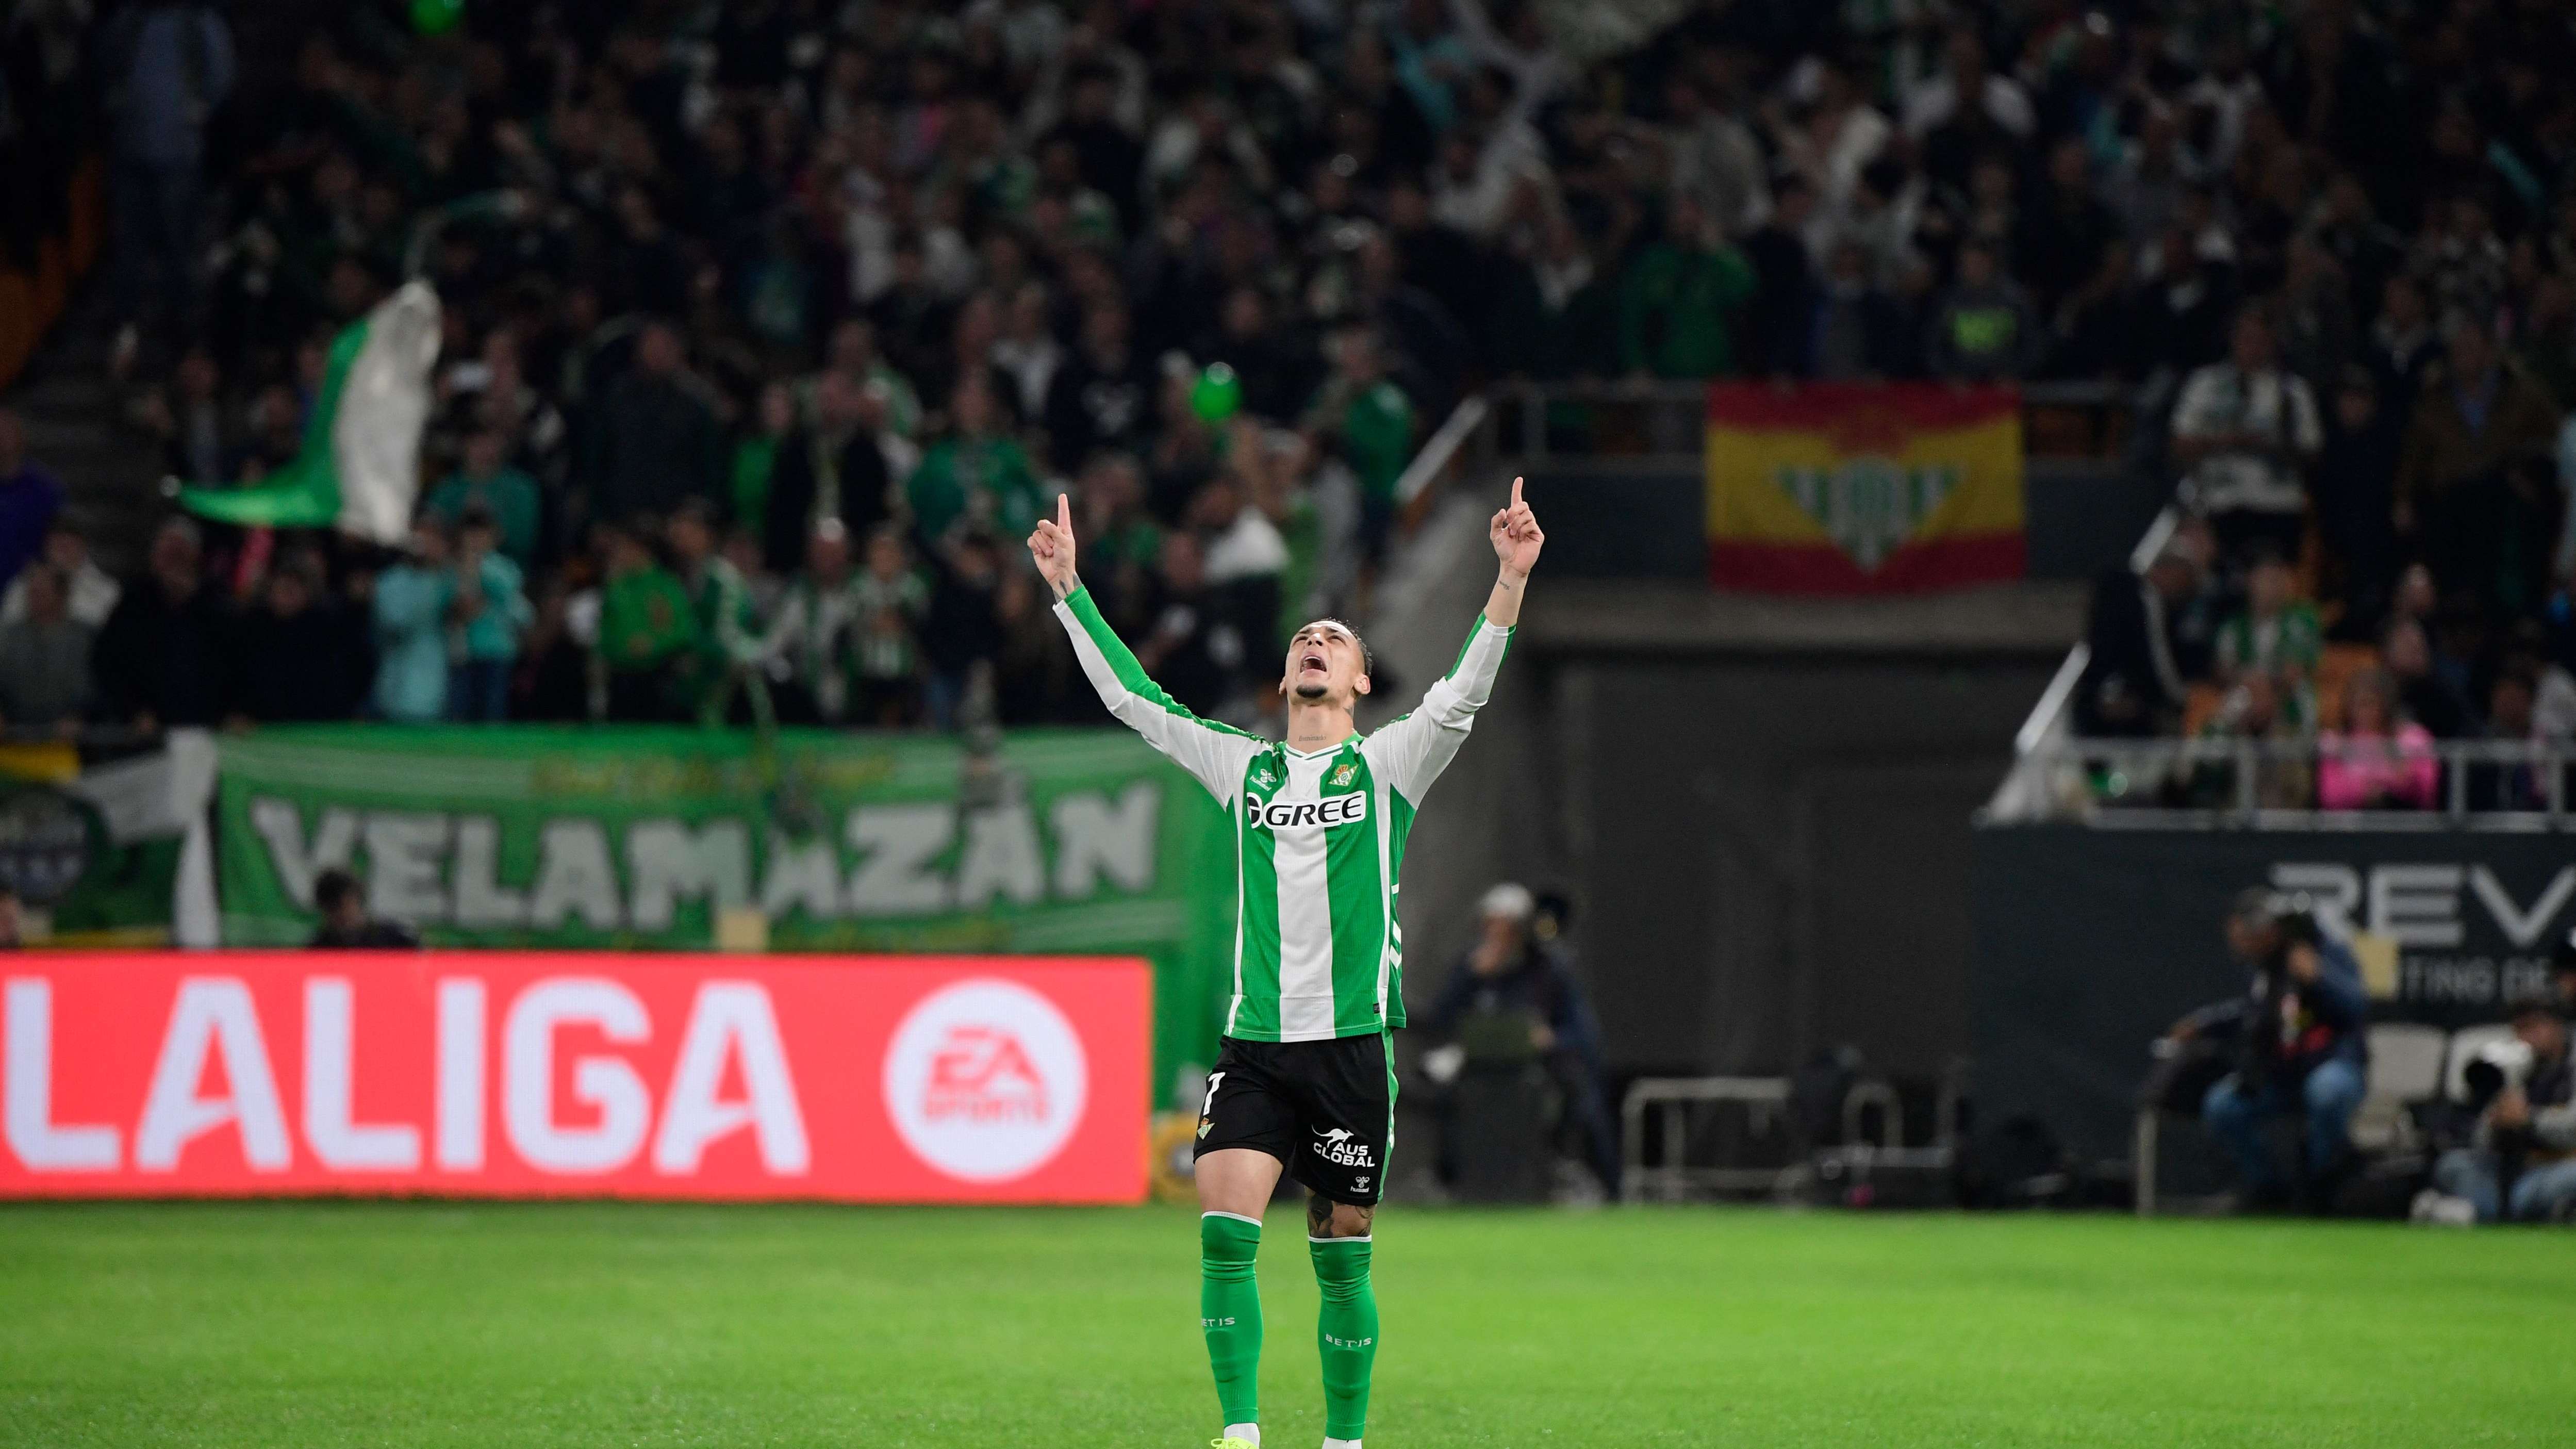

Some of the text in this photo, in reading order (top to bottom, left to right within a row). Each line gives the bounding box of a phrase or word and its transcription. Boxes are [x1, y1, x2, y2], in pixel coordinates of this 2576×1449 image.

[1249, 775, 1272, 792] hummel
[1266, 795, 1362, 827] GREE
[932, 1025, 1044, 1089] EA
[4, 976, 812, 1175] LALIGA
[1203, 1072, 1226, 1116] 7
[1314, 1142, 1375, 1167] GLOBAL
[1333, 1142, 1368, 1156] AUS
[1201, 1317, 1235, 1327] ETIS
[1325, 1333, 1372, 1347] BETIS
